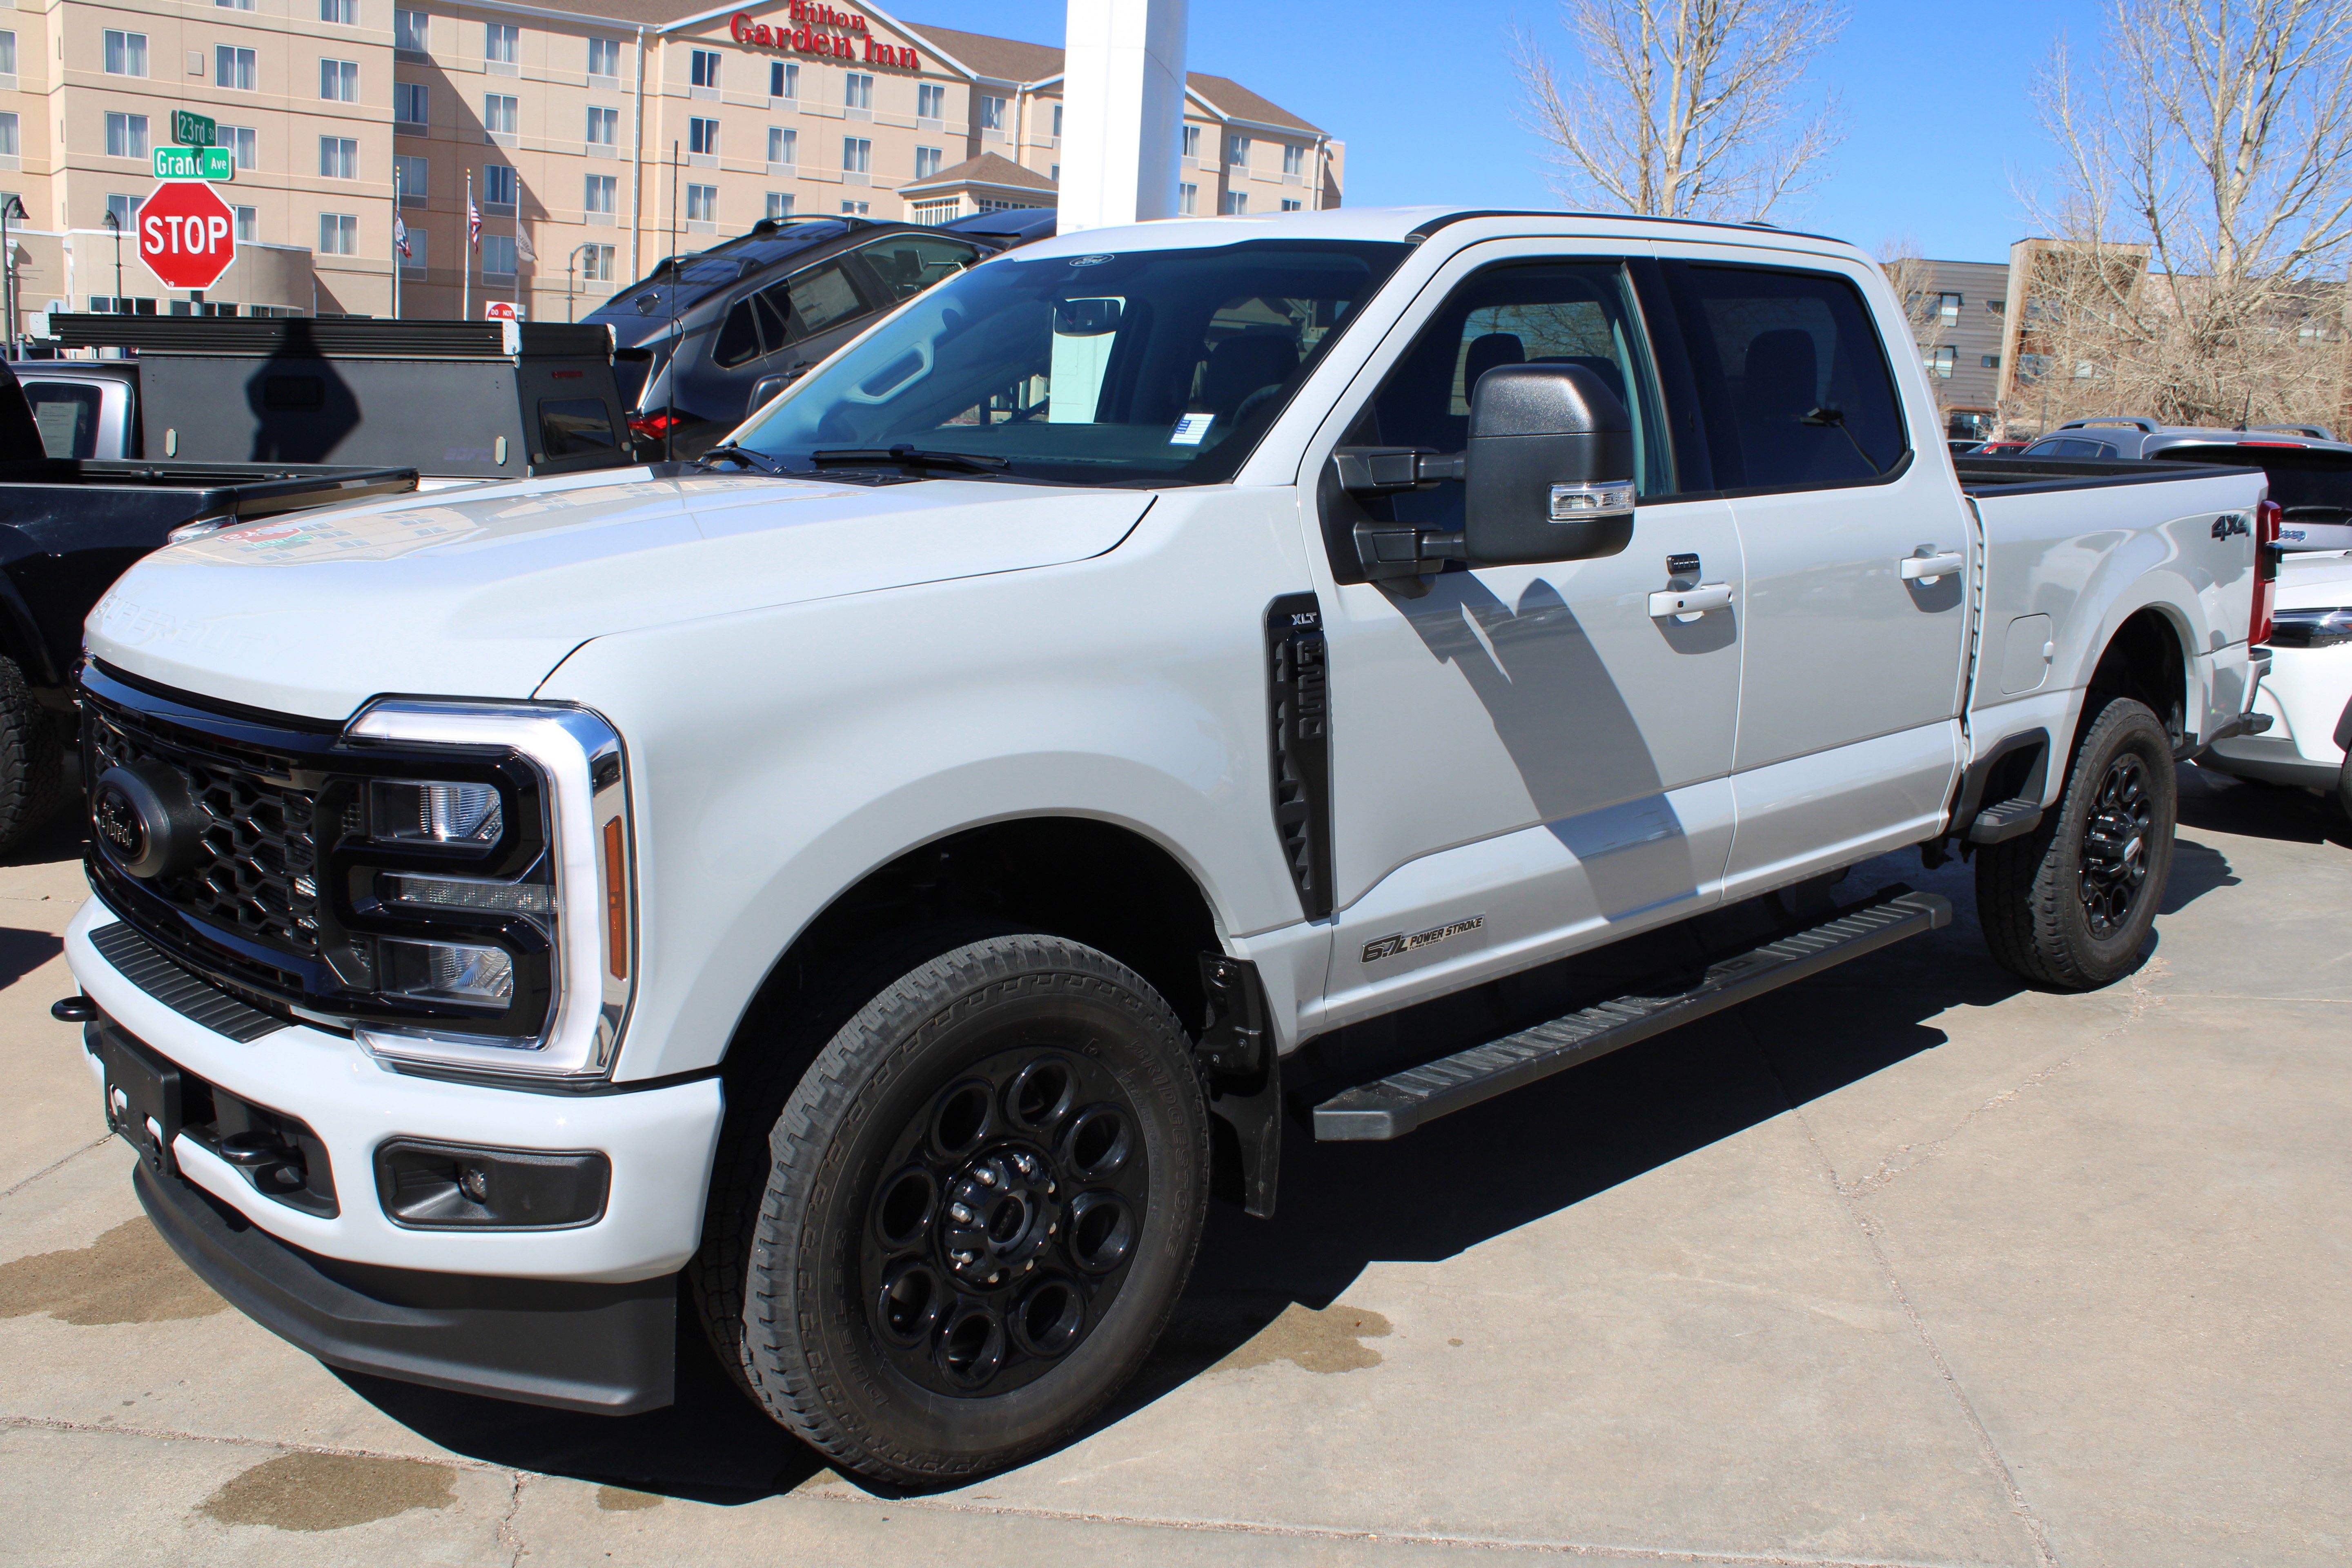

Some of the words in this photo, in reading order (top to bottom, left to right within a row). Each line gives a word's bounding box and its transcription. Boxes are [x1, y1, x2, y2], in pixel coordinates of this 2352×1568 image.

[788, 0, 866, 30] Hilton
[729, 12, 853, 58] Garden
[862, 33, 918, 68] Inn
[180, 115, 205, 144] 23rd
[208, 128, 215, 140] St
[157, 151, 204, 175] Grand
[211, 157, 227, 170] Ave
[145, 215, 228, 254] STOP
[1291, 612, 1317, 625] XLT
[1361, 933, 1408, 964] 6.7L
[1410, 928, 1445, 947] POWER
[1445, 917, 1483, 936] STROKE
[1125, 1038, 1189, 1259] BRIDGESTONE
[831, 1227, 890, 1408] DUELER
